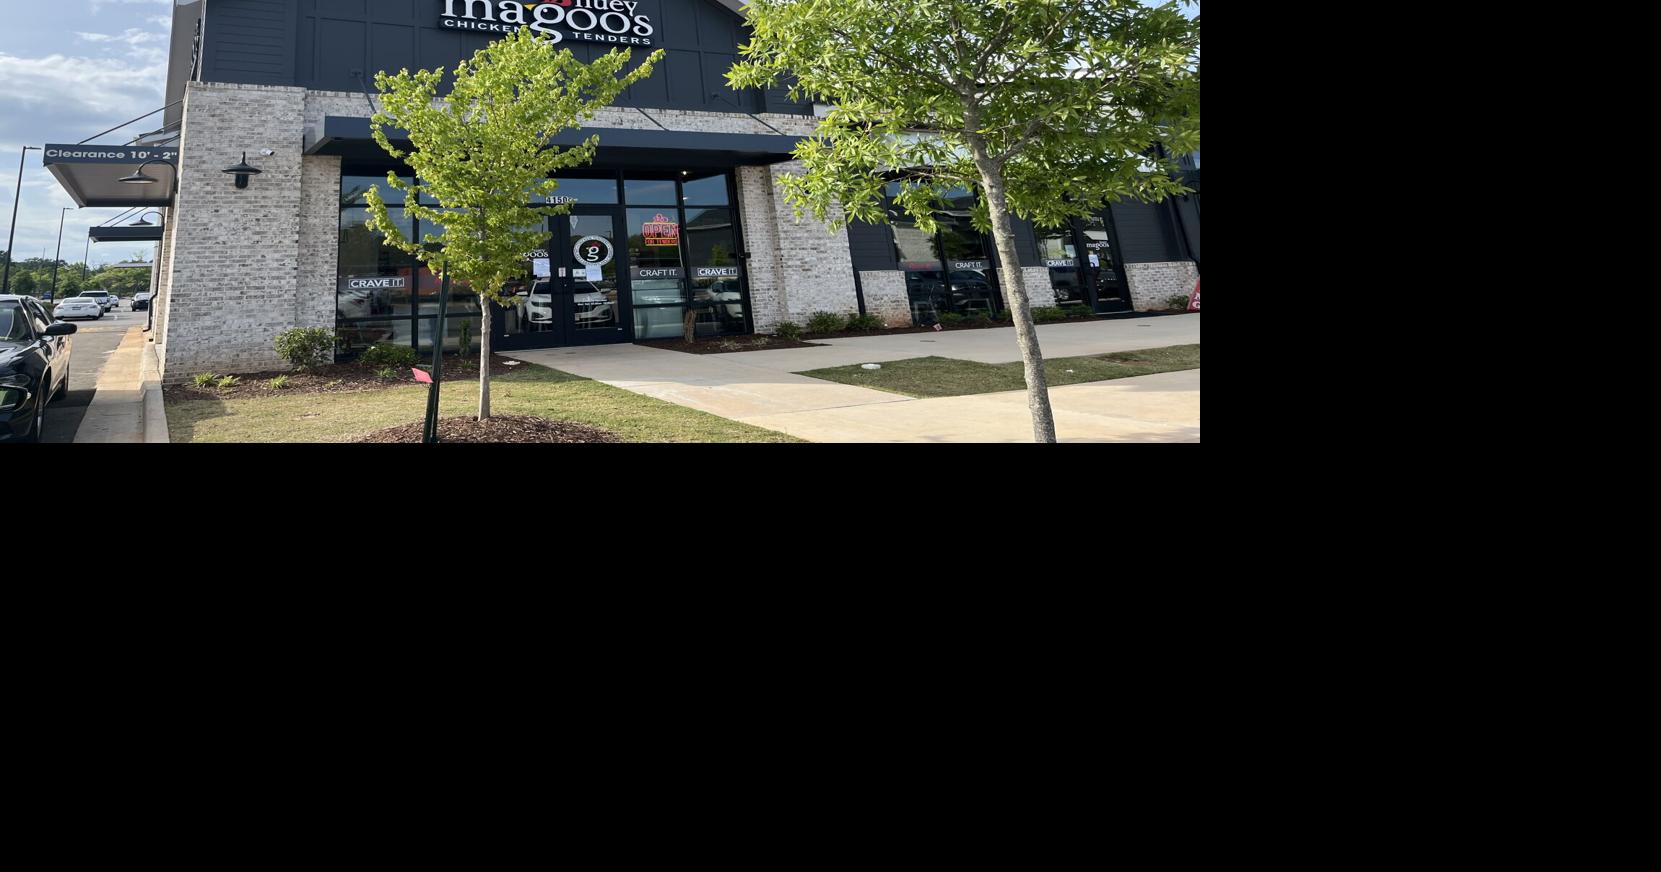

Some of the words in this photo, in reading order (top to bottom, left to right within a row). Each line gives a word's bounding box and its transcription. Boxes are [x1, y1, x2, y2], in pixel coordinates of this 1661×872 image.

[572, 32, 652, 45] TENDERS
[45, 148, 126, 159] Clearance
[131, 151, 151, 159] 10'
[162, 151, 178, 160] 2"
[642, 223, 678, 237] OPEN
[955, 261, 975, 269] CRAFT
[639, 269, 667, 277] CRAFT
[669, 268, 678, 276] IT.
[699, 268, 727, 276] CRAVE
[350, 279, 390, 288] CRAVE
